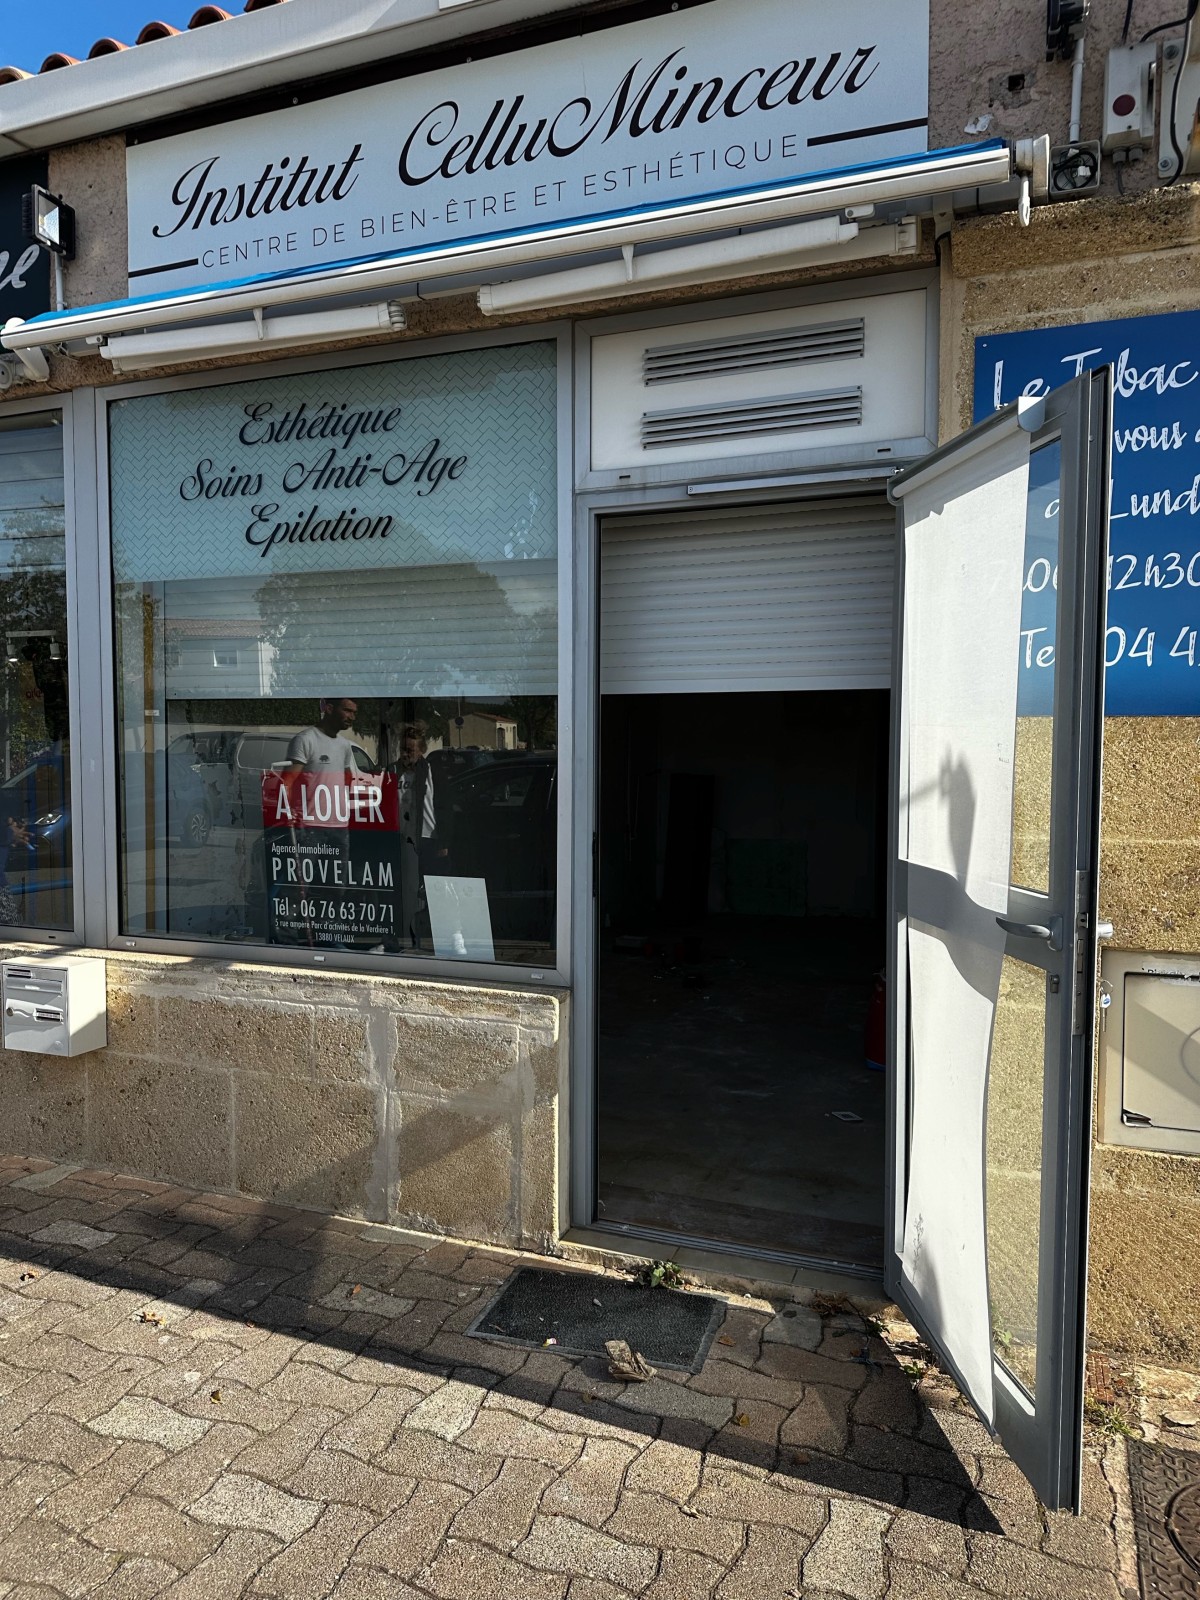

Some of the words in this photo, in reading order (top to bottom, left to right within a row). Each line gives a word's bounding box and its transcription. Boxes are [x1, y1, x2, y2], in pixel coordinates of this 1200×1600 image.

[152, 143, 364, 238] Institut
[202, 233, 299, 269] CENTRE
[313, 223, 346, 247] DE
[360, 191, 517, 238] BIEN-ÊTRE
[534, 181, 566, 207] ET
[583, 134, 798, 197] ESTHÉTIQUE
[1061, 347, 1199, 398] Tbac
[239, 402, 401, 450] Esthétique
[1114, 421, 1187, 454] vous
[180, 458, 263, 501] Soins
[283, 438, 468, 497] Anti-Age
[245, 503, 396, 558] Epilation
[1105, 626, 1155, 667] 04
[1169, 626, 1200, 667] 4
[276, 784, 292, 820] A
[301, 784, 385, 823] LOUER
[271, 842, 296, 855] Agence
[297, 843, 340, 855] Immobilière
[272, 857, 394, 887] PROVELAM
[273, 897, 289, 916] Tél
[300, 899, 316, 917] 06
[320, 900, 336, 919] 76
[340, 902, 355, 920] 63
[359, 903, 376, 921] 70
[379, 904, 394, 922] 71
[311, 920, 323, 929] Parc
[351, 922, 358, 931] de
[360, 923, 365, 932] la
[315, 932, 333, 941] 13880
[333, 933, 355, 943] VELAUX
